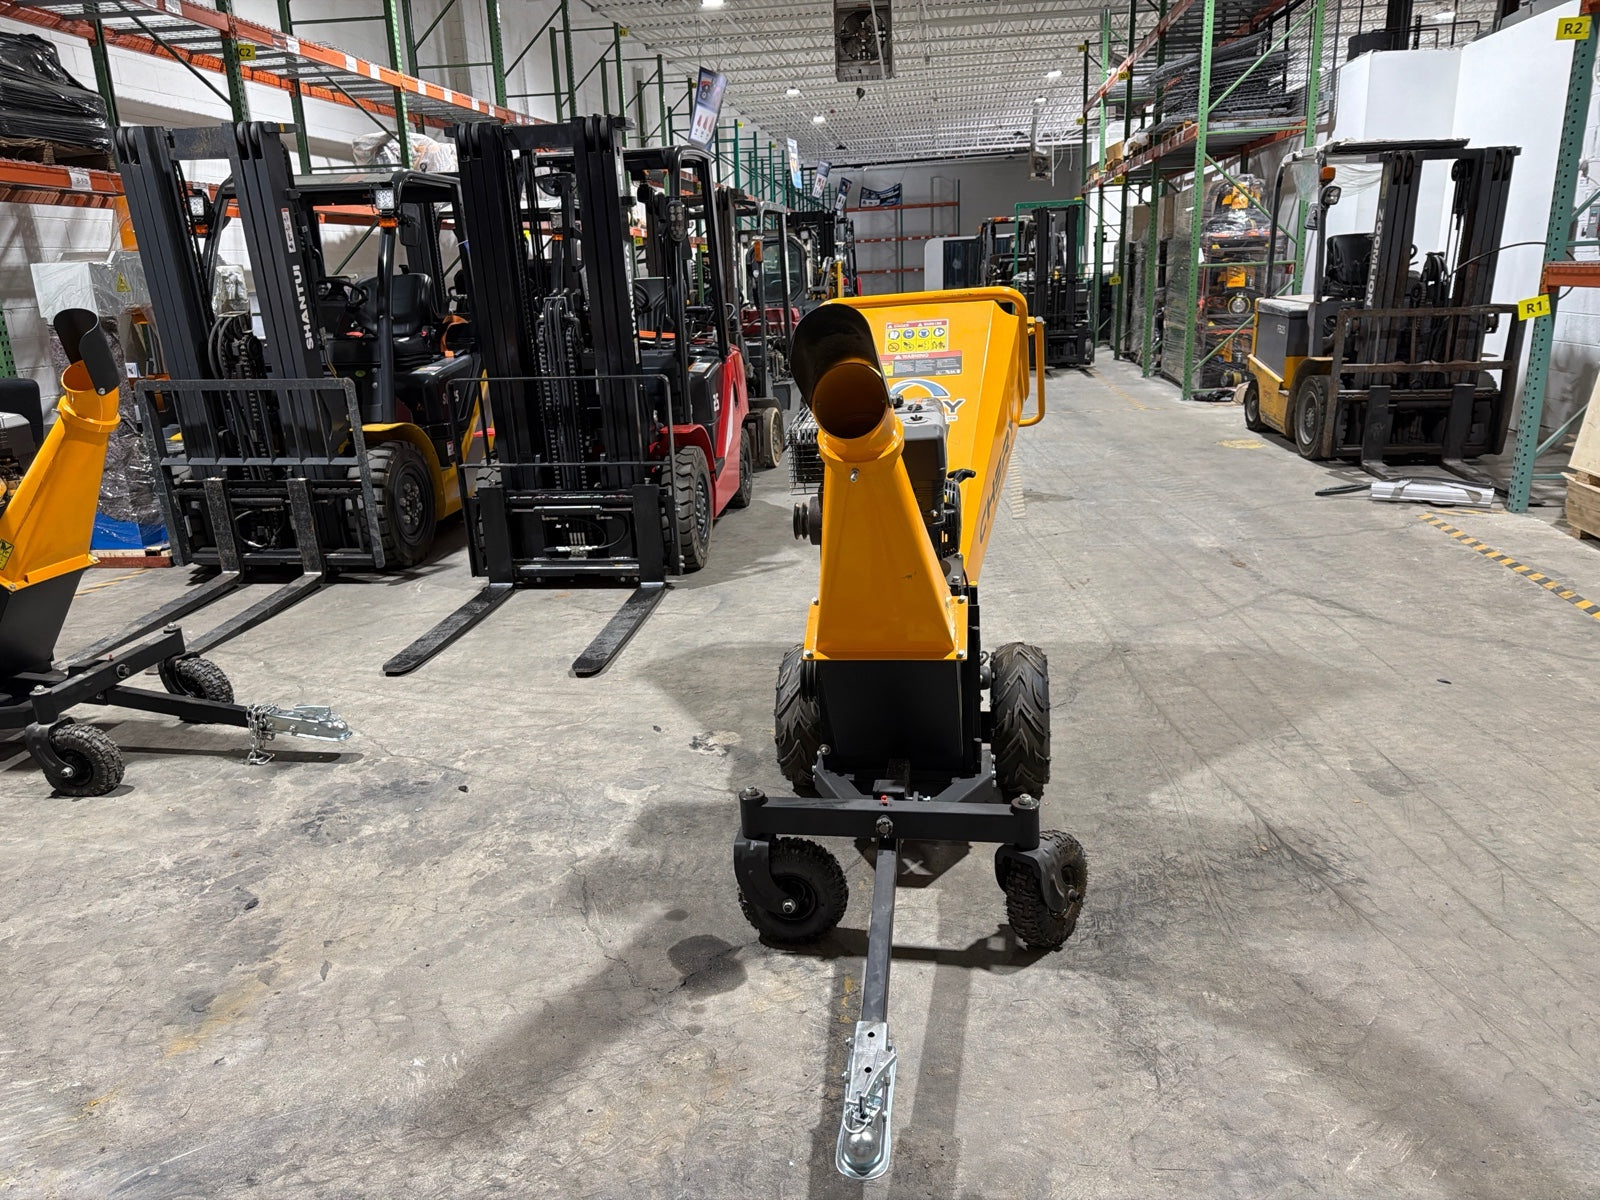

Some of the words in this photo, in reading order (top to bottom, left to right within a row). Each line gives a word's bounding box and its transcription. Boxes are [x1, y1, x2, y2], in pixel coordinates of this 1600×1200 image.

[1564, 22, 1583, 35] R2
[239, 48, 252, 57] C2
[1366, 208, 1384, 307] ZOOMLION
[292, 264, 315, 350] SHANTUI
[1526, 300, 1543, 314] R1
